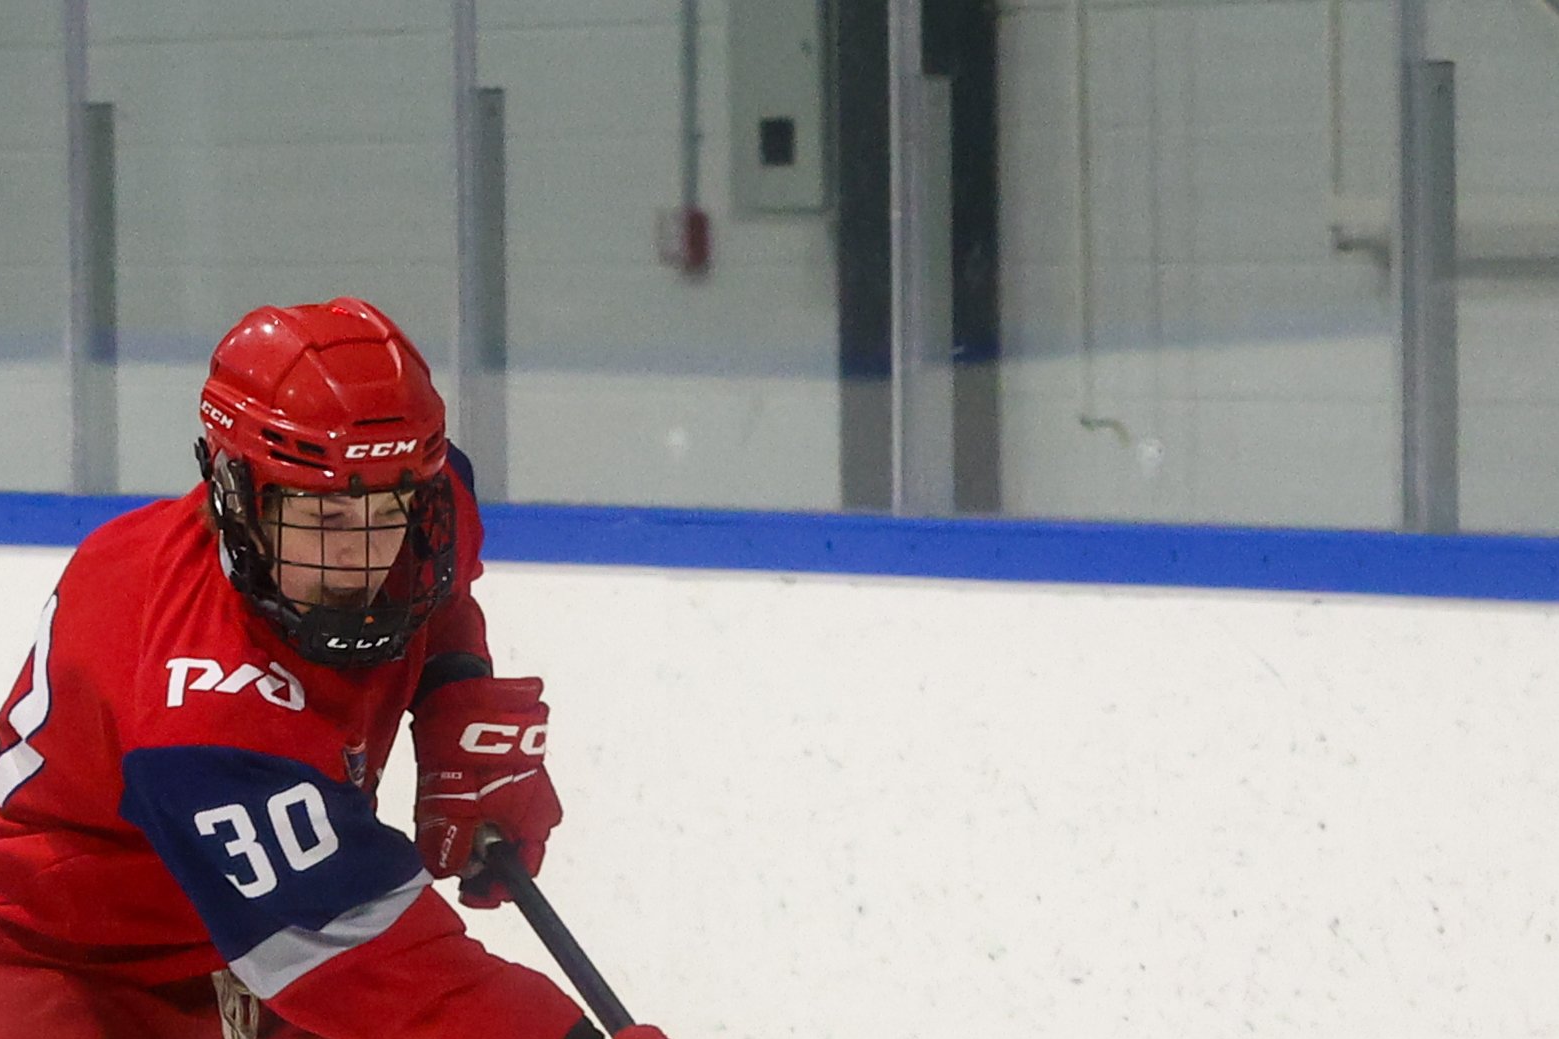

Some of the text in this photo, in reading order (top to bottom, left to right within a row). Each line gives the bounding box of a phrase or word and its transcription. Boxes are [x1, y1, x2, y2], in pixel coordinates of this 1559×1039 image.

[201, 401, 234, 429] CCM
[345, 439, 418, 459] CCM
[194, 781, 339, 899] 30
